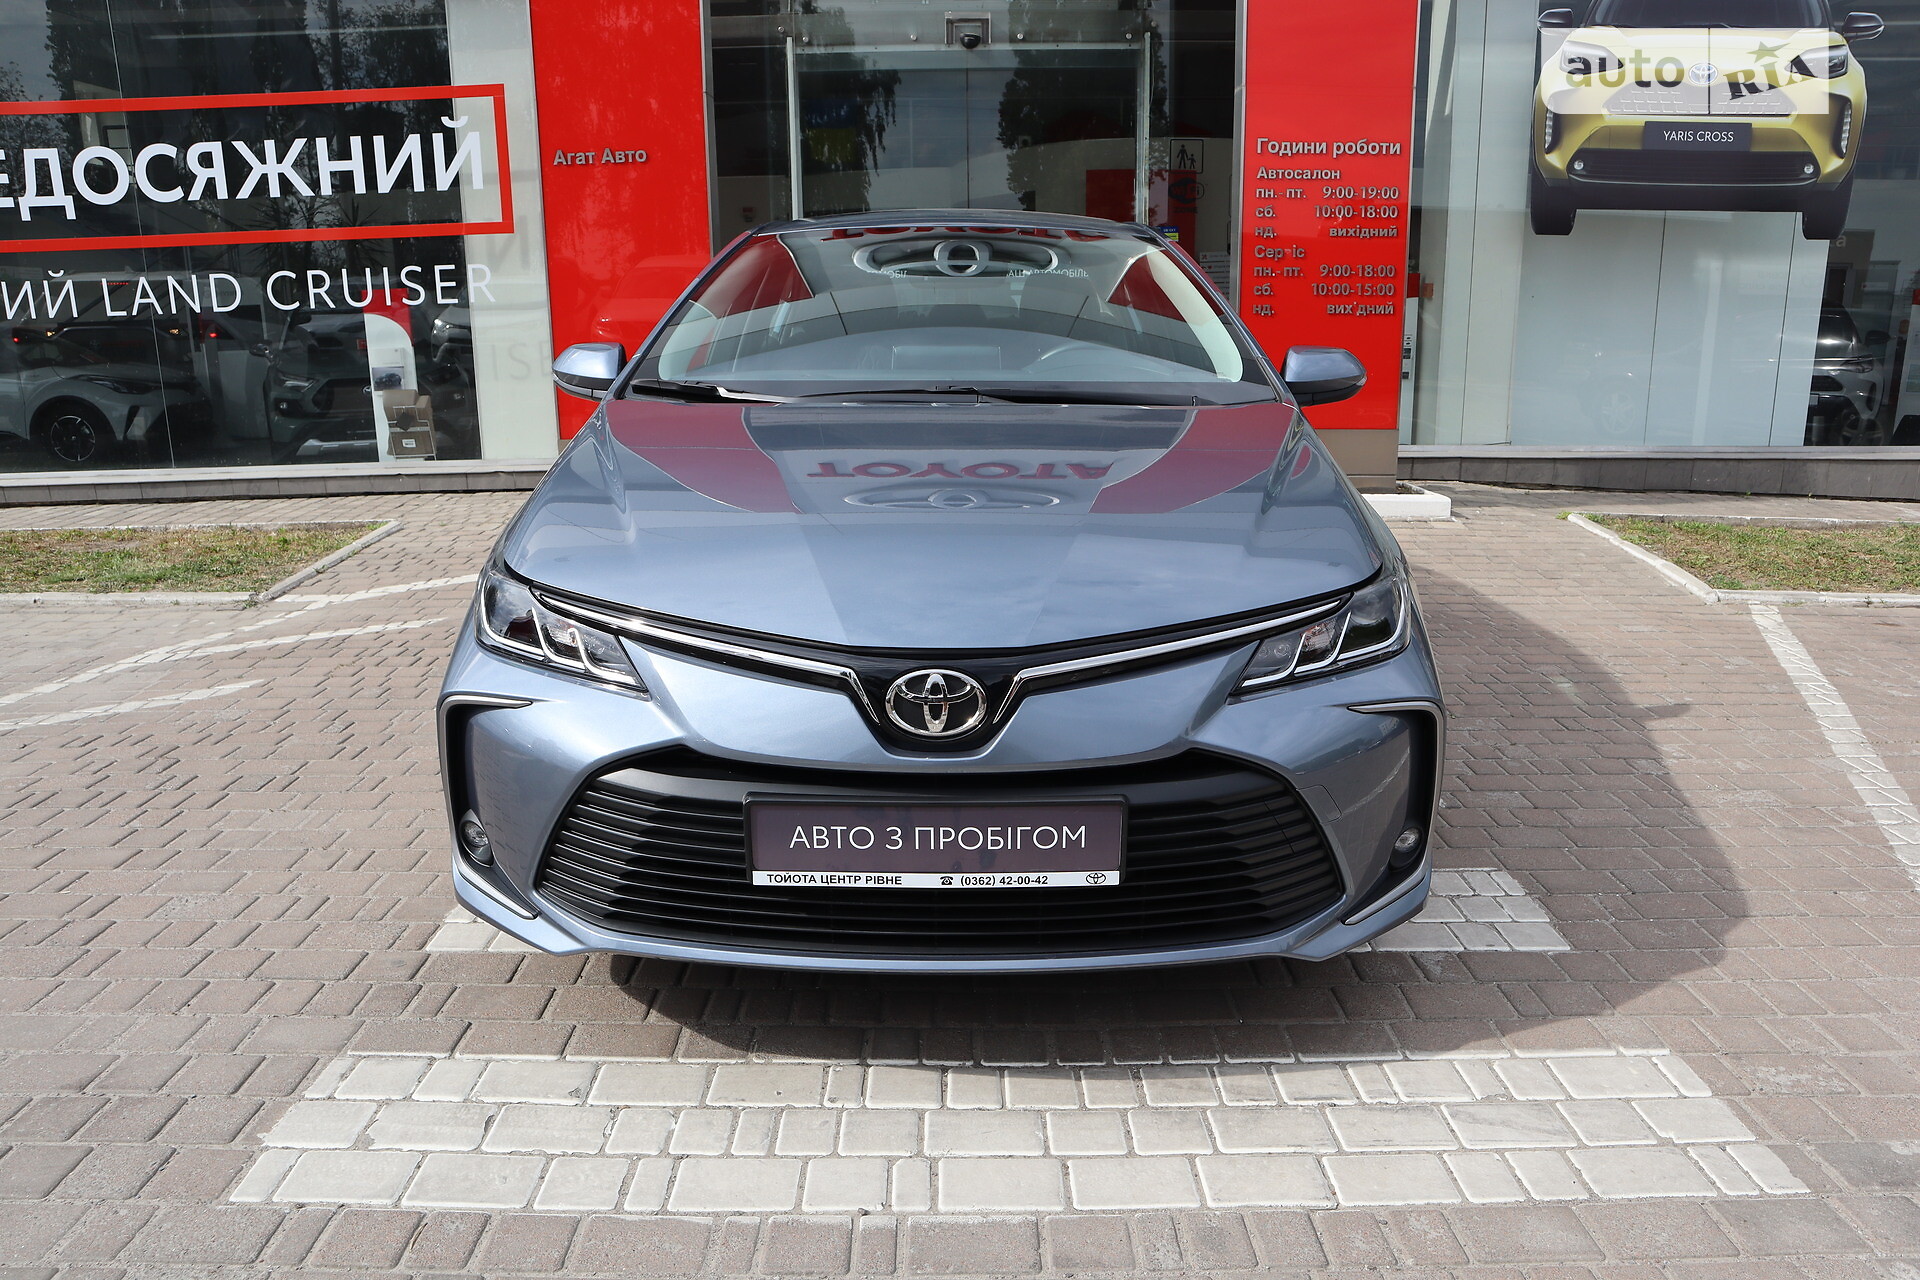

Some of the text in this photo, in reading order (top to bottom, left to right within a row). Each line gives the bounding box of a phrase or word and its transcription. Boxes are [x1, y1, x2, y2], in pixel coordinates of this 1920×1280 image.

[1663, 130, 1735, 142] YARIS CROSS
[1256, 137, 1401, 158] Години роботи
[553, 147, 648, 166] Агат Авто
[1256, 166, 1341, 180] Автосалон
[1322, 186, 1400, 200] 9:00-19:00
[1255, 205, 1399, 219] сб. 10:00-18:00
[1254, 225, 1399, 239] нд. вихідний
[1254, 244, 1306, 260] Серіс
[1319, 264, 1396, 278] 9:00-18:00
[101, 273, 242, 317] LAND
[266, 263, 497, 311] CRUISER
[1253, 283, 1396, 297] сб. 10:00-15:00
[1253, 300, 1394, 316] нд. вихдний
[789, 825, 1087, 851] АВТО З ПРОБІГОМ
[766, 871, 1049, 888] ТОЙОТА ЦЕНТР РІВНЕ (0362) 42-00-42
